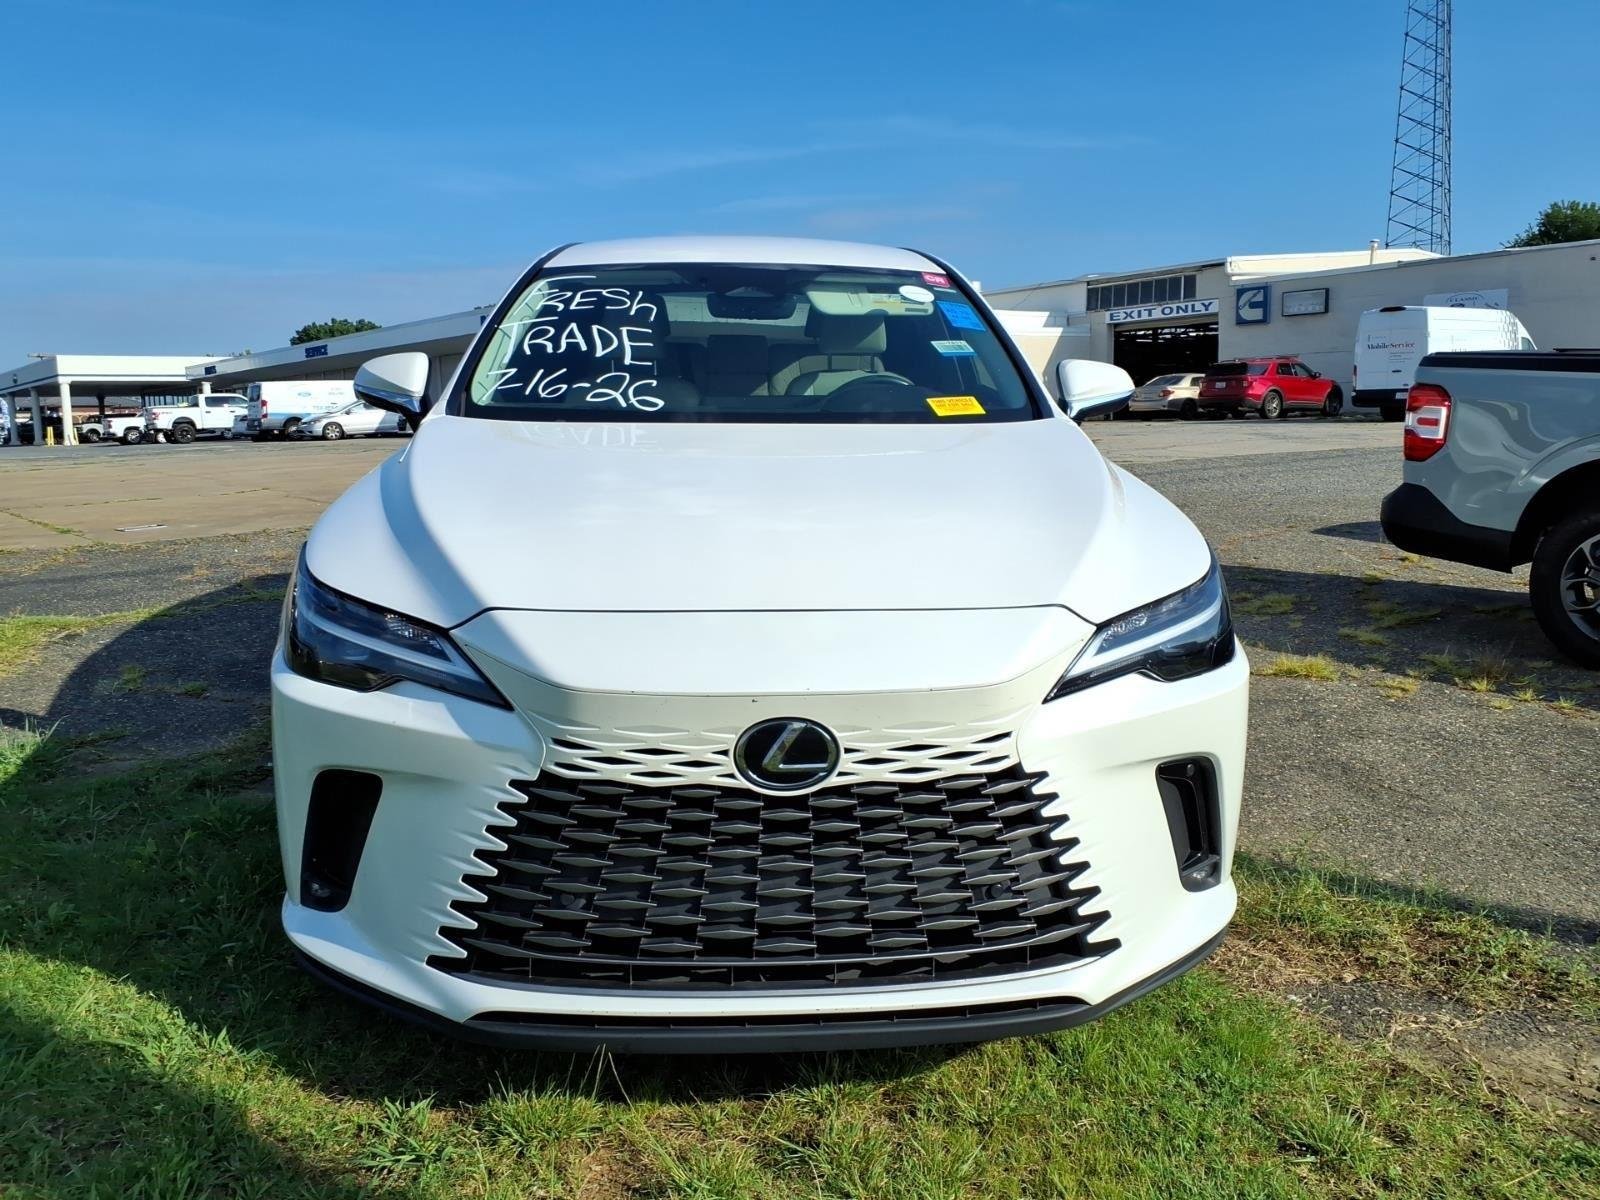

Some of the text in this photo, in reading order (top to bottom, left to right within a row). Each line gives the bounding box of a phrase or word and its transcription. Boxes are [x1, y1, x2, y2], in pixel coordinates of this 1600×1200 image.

[1109, 301, 1214, 321] EXIT ONLY
[495, 316, 654, 365] TRADE
